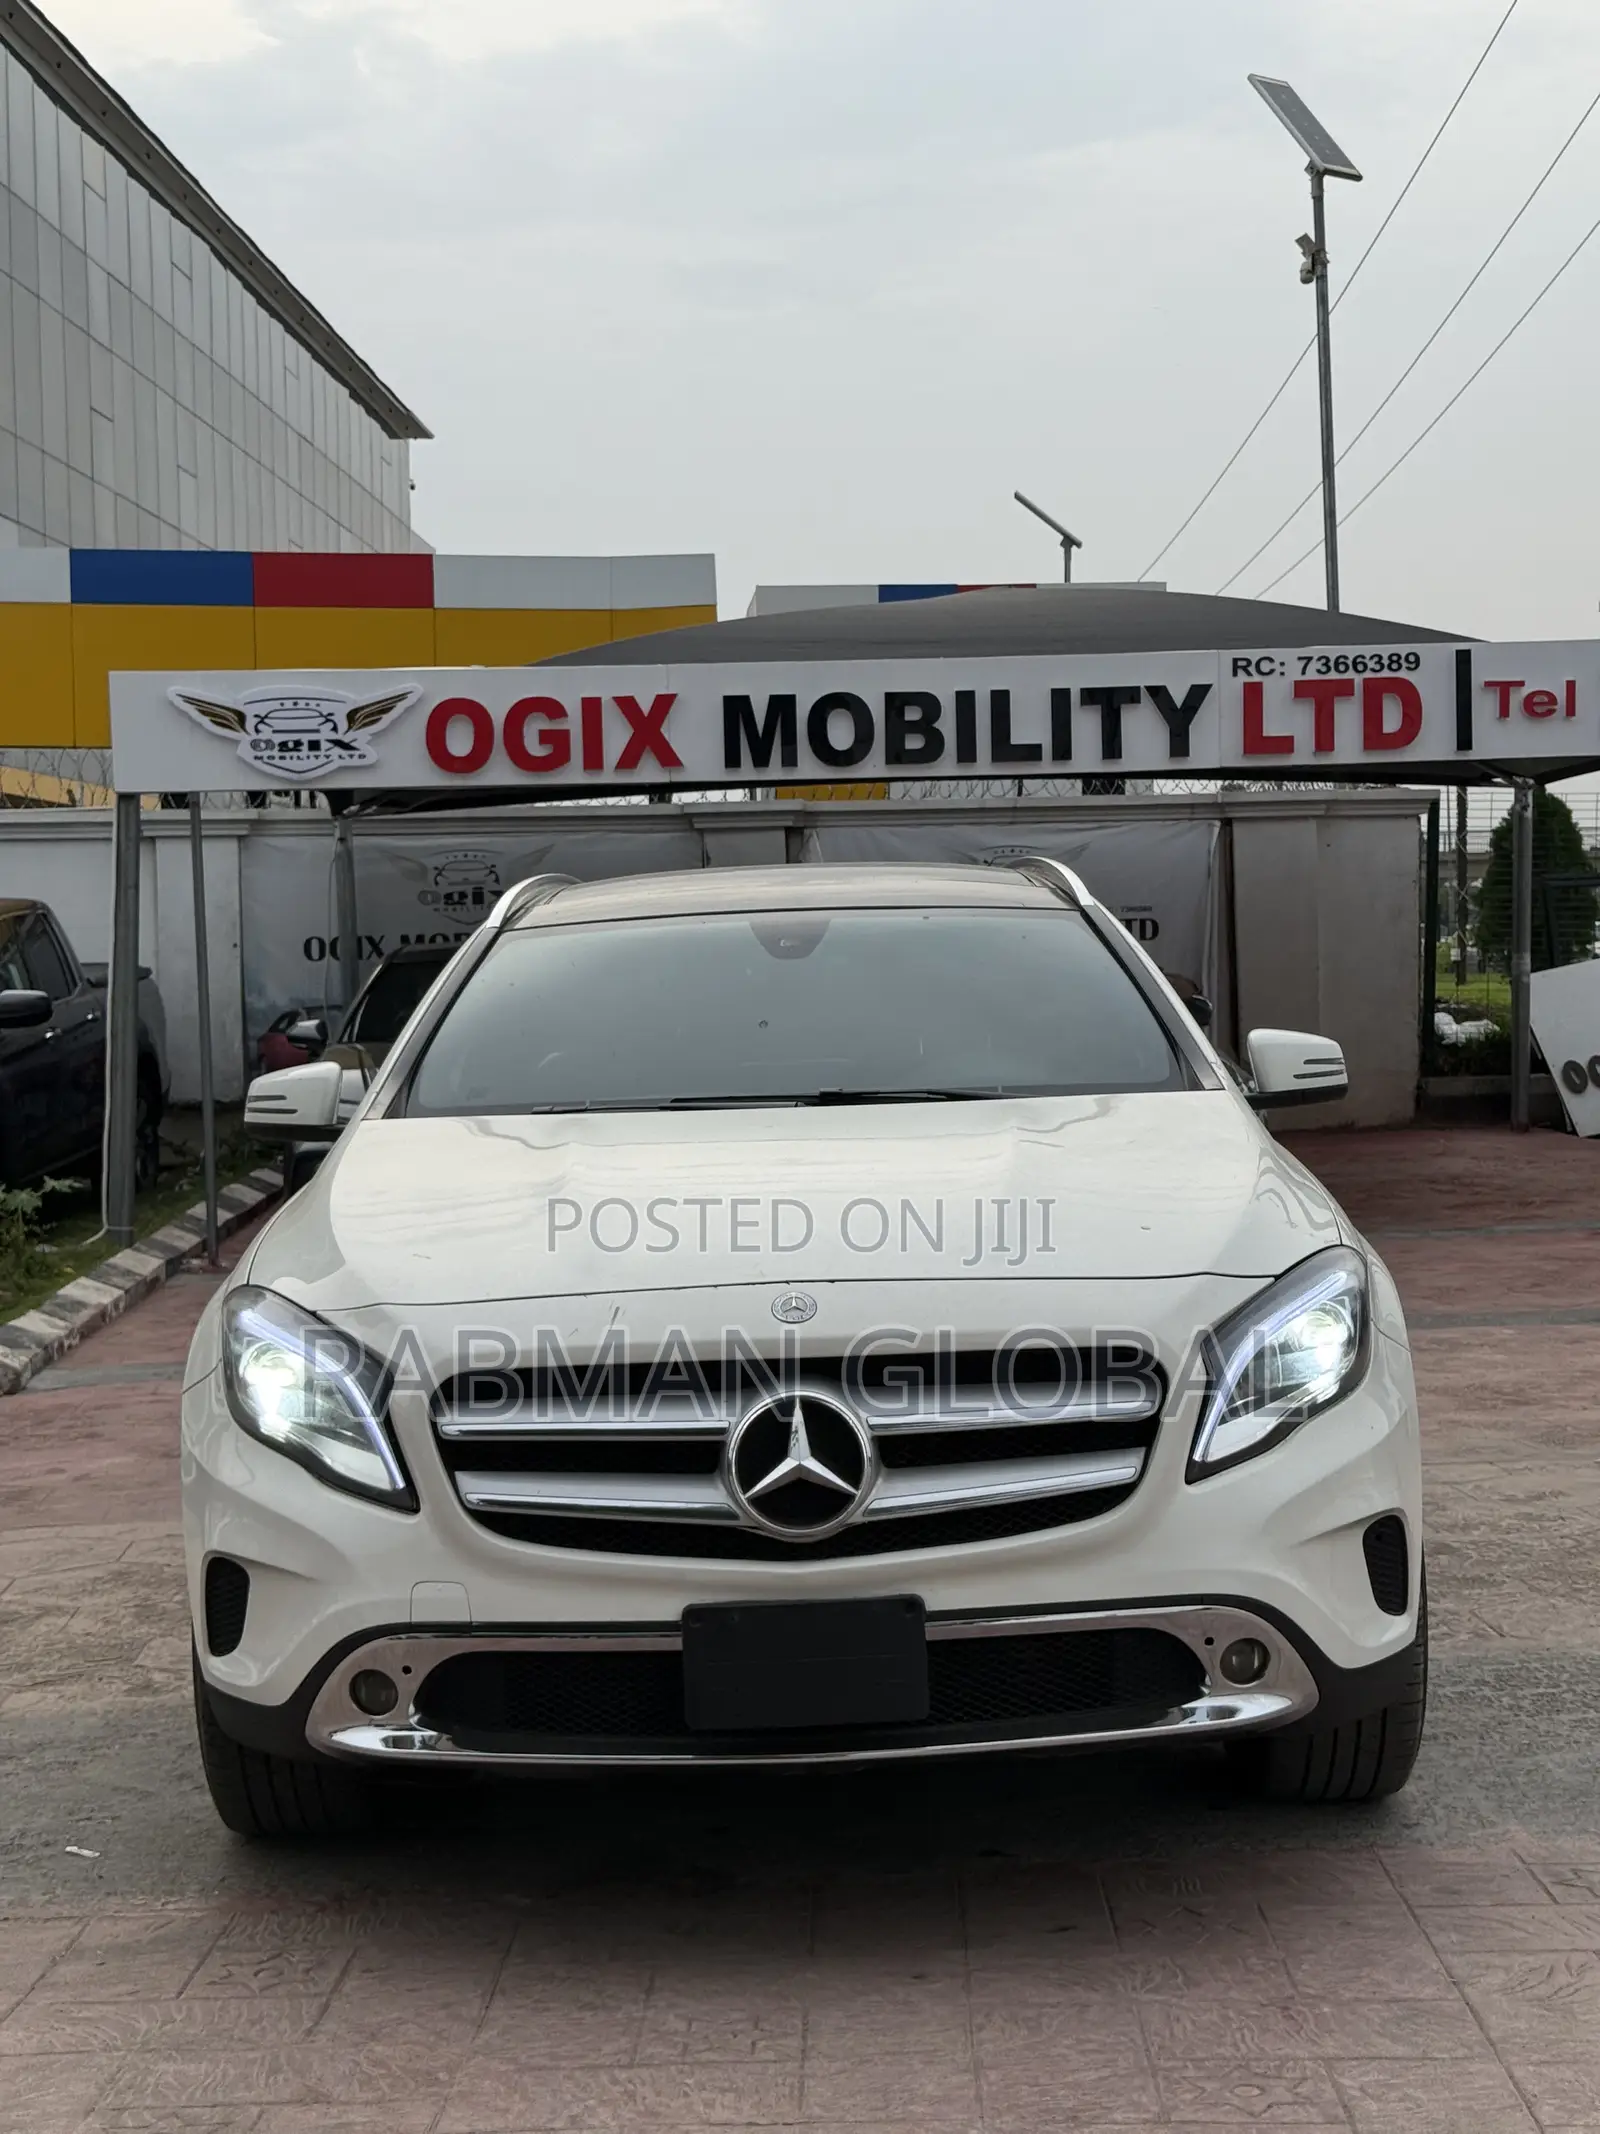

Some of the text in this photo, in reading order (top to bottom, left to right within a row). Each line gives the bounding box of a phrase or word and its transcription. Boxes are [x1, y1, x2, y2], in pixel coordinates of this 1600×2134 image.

[1232, 652, 1421, 677] RC: 7366389
[426, 677, 1576, 774] OGIX MOBILITY LTD Tel
